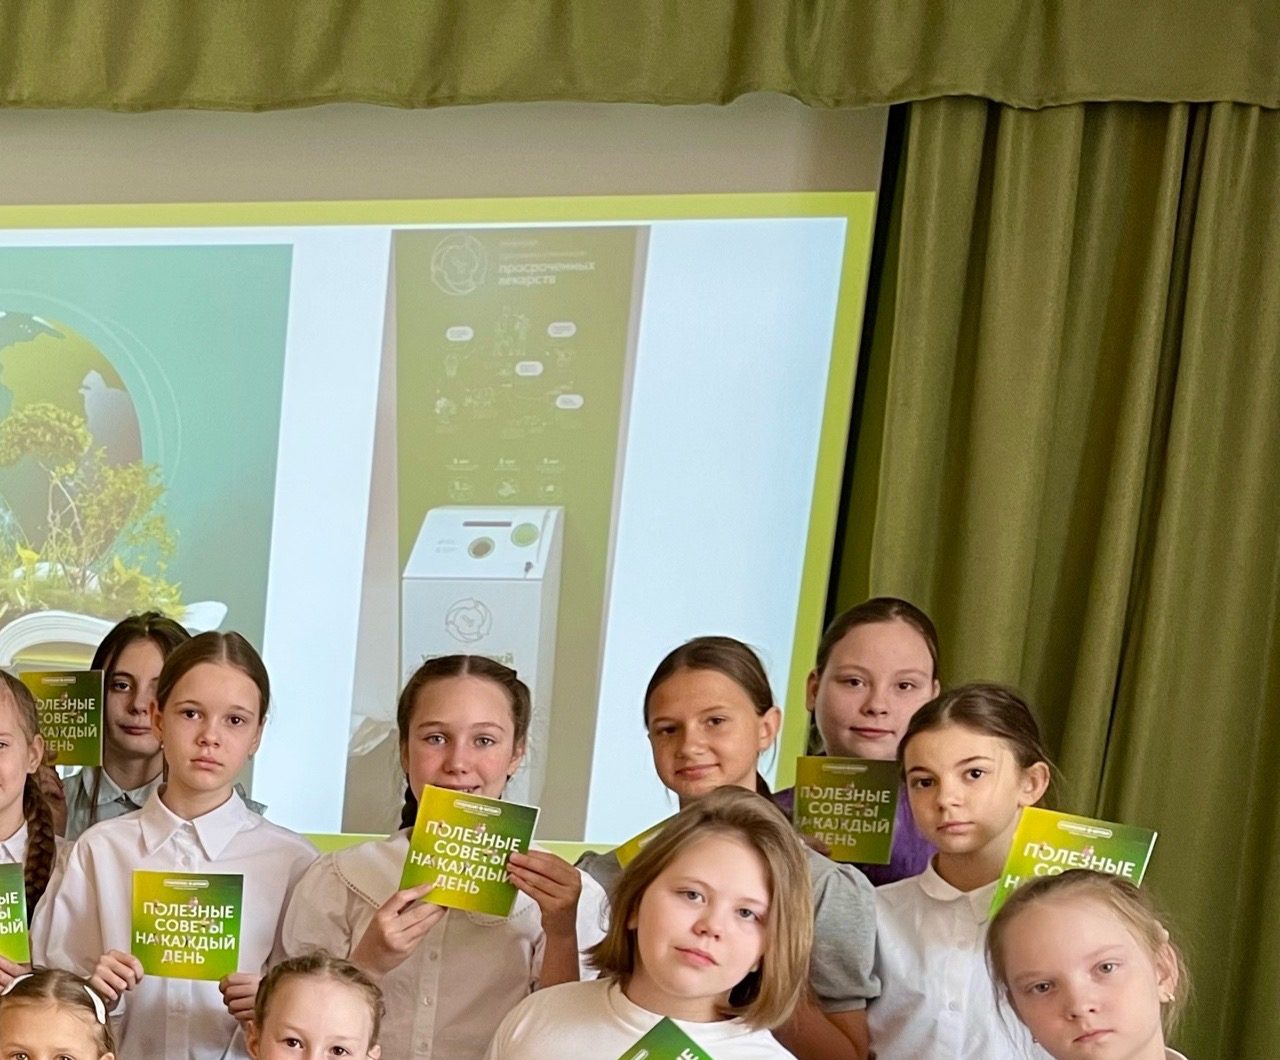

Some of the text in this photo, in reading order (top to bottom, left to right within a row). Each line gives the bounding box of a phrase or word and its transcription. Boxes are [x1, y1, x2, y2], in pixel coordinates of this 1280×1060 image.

[36, 698, 96, 710] ОЛЕЗНЫЕ
[800, 786, 890, 803] ПОЛЕЗНЫЕ
[808, 801, 878, 818] СОВЕТЫ
[813, 816, 890, 834] КАЖДЫЙ
[425, 820, 521, 852] ПОЛЕЗНЫЕ
[410, 850, 434, 868] НА
[434, 840, 507, 866] СОВЕТЫ
[1024, 842, 1136, 878] ПОЛЕЗНЫЕ
[432, 874, 480, 894] ДЕНЬ
[144, 902, 234, 918] ПОЛЕЗНЫЕ
[155, 918, 224, 934] СОВЕТЫ
[136, 931, 235, 951] НА КАЖДЫЙ
[161, 949, 205, 964] ДЕНЬ
